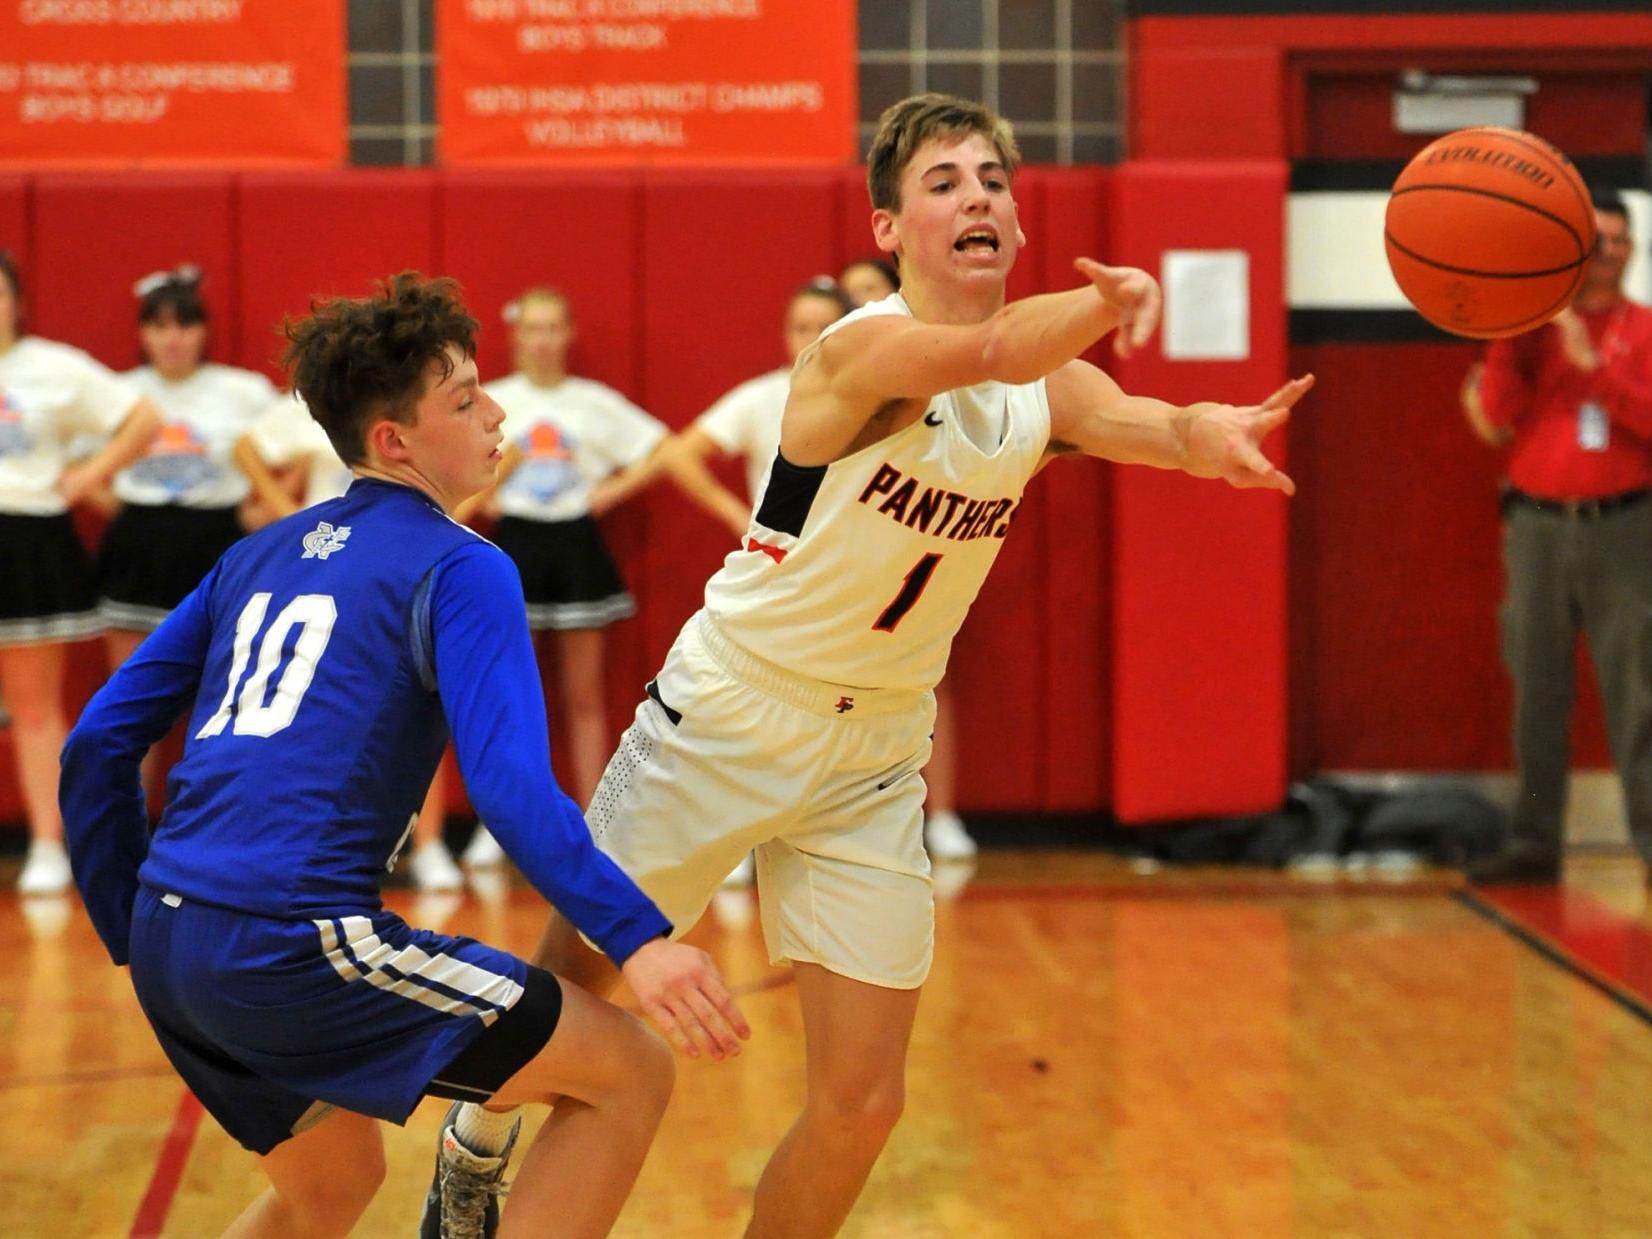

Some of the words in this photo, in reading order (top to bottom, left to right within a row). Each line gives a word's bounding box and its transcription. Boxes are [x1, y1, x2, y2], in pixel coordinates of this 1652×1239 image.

[518, 25, 584, 52] BOYS
[590, 23, 667, 50] TRACK
[119, 62, 293, 91] CONFERENCE
[22, 95, 95, 122] BOYS
[101, 94, 168, 122] GOLF
[595, 82, 707, 113] DISTRICT
[713, 81, 823, 114] CHAMPS
[525, 117, 686, 147] VOLLEYBALL
[1426, 147, 1555, 189] EVOLUTION
[871, 552, 944, 633] 1
[195, 592, 338, 740] 10
